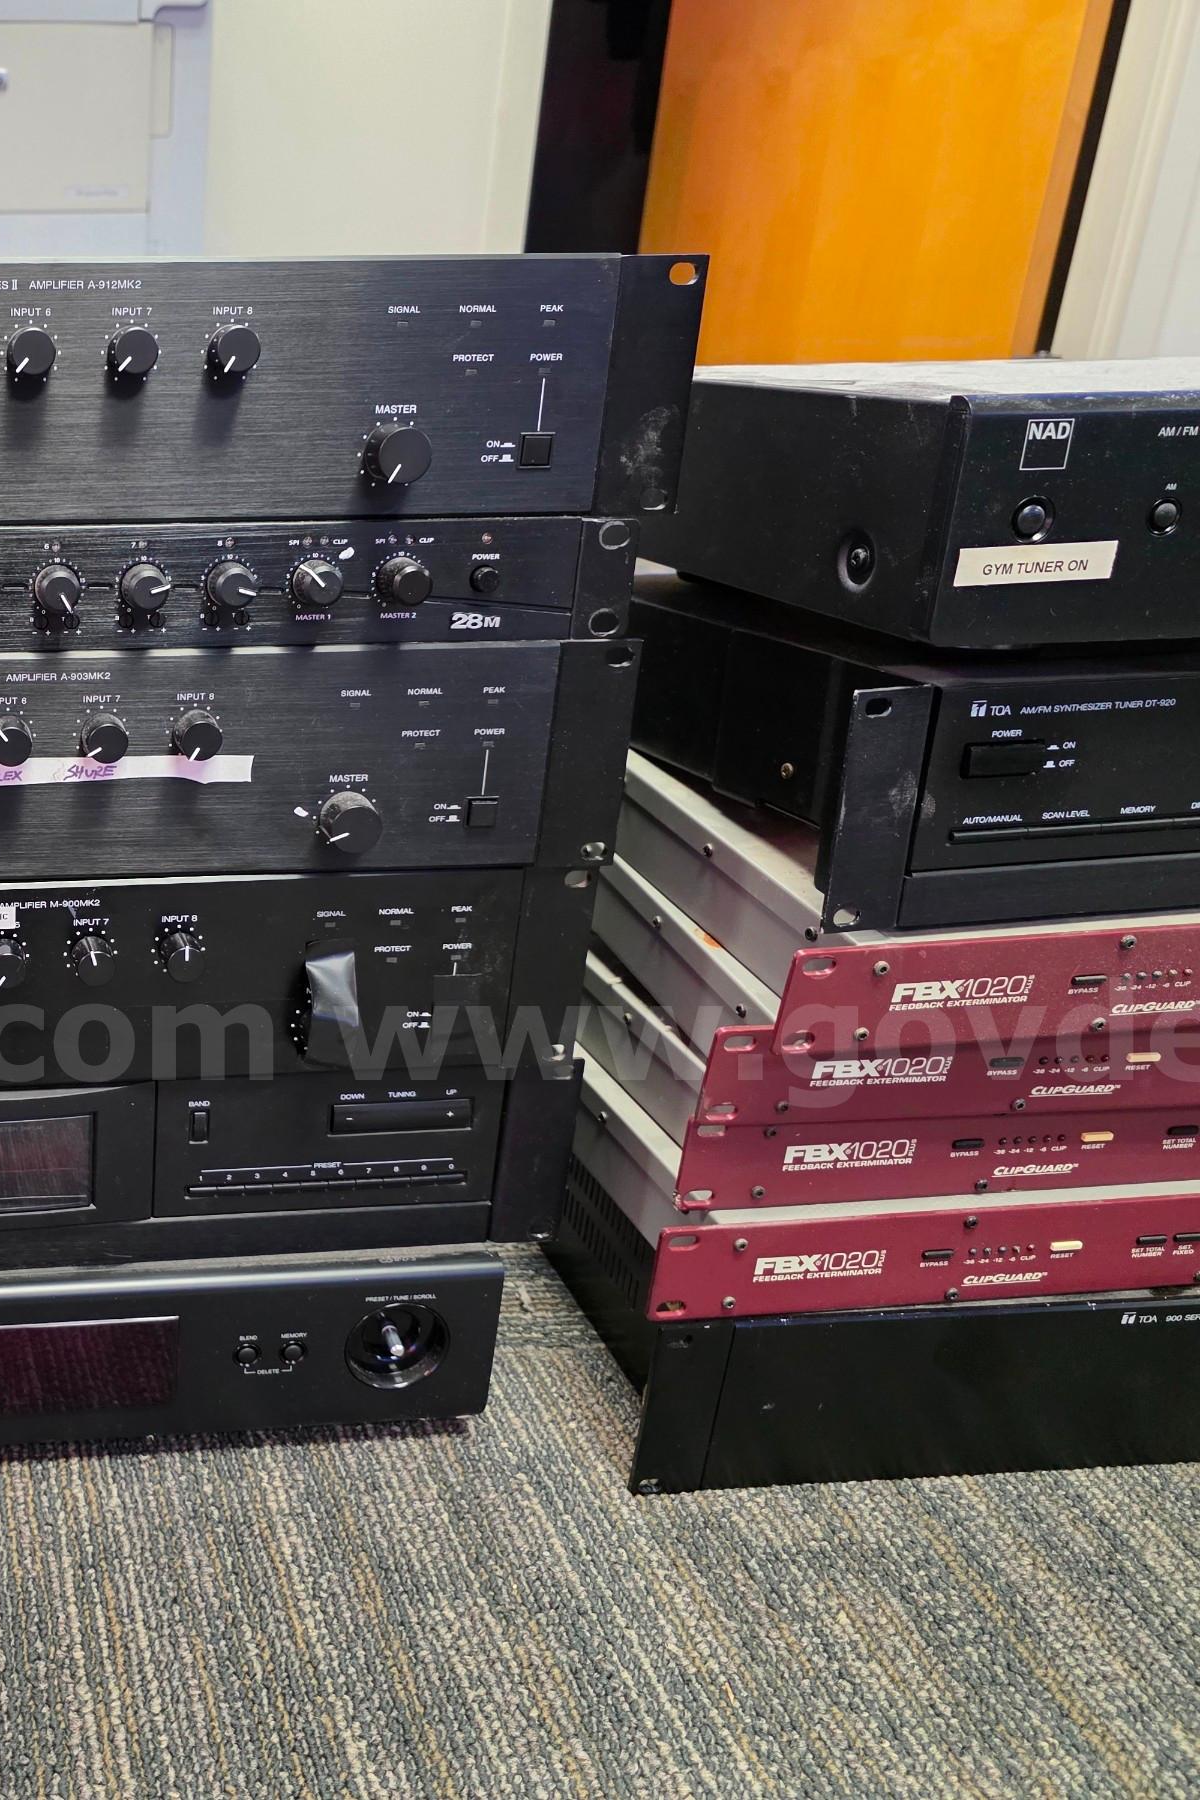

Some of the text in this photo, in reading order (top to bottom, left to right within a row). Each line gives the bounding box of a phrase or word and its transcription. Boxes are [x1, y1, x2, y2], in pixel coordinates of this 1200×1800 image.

[28, 280, 84, 290] AMPLIFIER
[87, 280, 142, 290] A-912MK2
[212, 306, 253, 316] INPUT 8
[387, 305, 421, 314] SIGNAL
[459, 305, 497, 313] NORMAL
[539, 304, 564, 313] PEAK
[452, 354, 494, 363] PROTECT
[530, 353, 563, 362] POWER
[375, 405, 417, 414] MASTER
[1027, 422, 1071, 440] NAD
[1157, 426, 1176, 437] AM
[1182, 426, 1199, 436] FM
[982, 559, 1089, 576] GYM TUNER ON
[450, 613, 500, 630] 28M
[5, 672, 57, 682] AMPLIFIER
[60, 672, 111, 682] A-903MK2
[341, 689, 372, 697] SIGNAL
[407, 687, 443, 696] NORMAL
[483, 686, 505, 694] PEAK
[176, 692, 215, 702] INPUT 8
[990, 705, 1011, 716] TOA
[1019, 698, 1177, 715] AM/FM SYNTHESIZER TUNER DT-920
[401, 729, 441, 737] PROTECT
[474, 727, 505, 735] POWER
[991, 730, 1022, 738] POWER
[329, 774, 368, 783] MASTER
[1120, 805, 1156, 815] MEMORY
[962, 814, 1023, 825] AUTO/MANUAL
[1042, 810, 1090, 820] SCAN LEVEL
[0, 900, 47, 910] AMPLIFIER
[50, 899, 100, 909] M-900MK2
[451, 905, 473, 913] PEAK
[316, 910, 346, 918] SIGNAL
[161, 915, 198, 923] INPUT 8
[374, 945, 412, 953] PROTECT
[442, 942, 472, 950] POWER
[889, 995, 1027, 1012] FEEDBACK EXTERMINATOR
[810, 1074, 946, 1088] FEEDBACK EXTERMINATOR
[340, 1093, 365, 1101] DOWN
[388, 1090, 416, 1098] TUNING
[313, 1161, 342, 1169] PRESET
[782, 1157, 913, 1172] FEEDBACK EXTERMINATOR
[1050, 1251, 1074, 1259] RESET
[752, 1267, 882, 1283] FEEDBACK EXTERMINATOR
